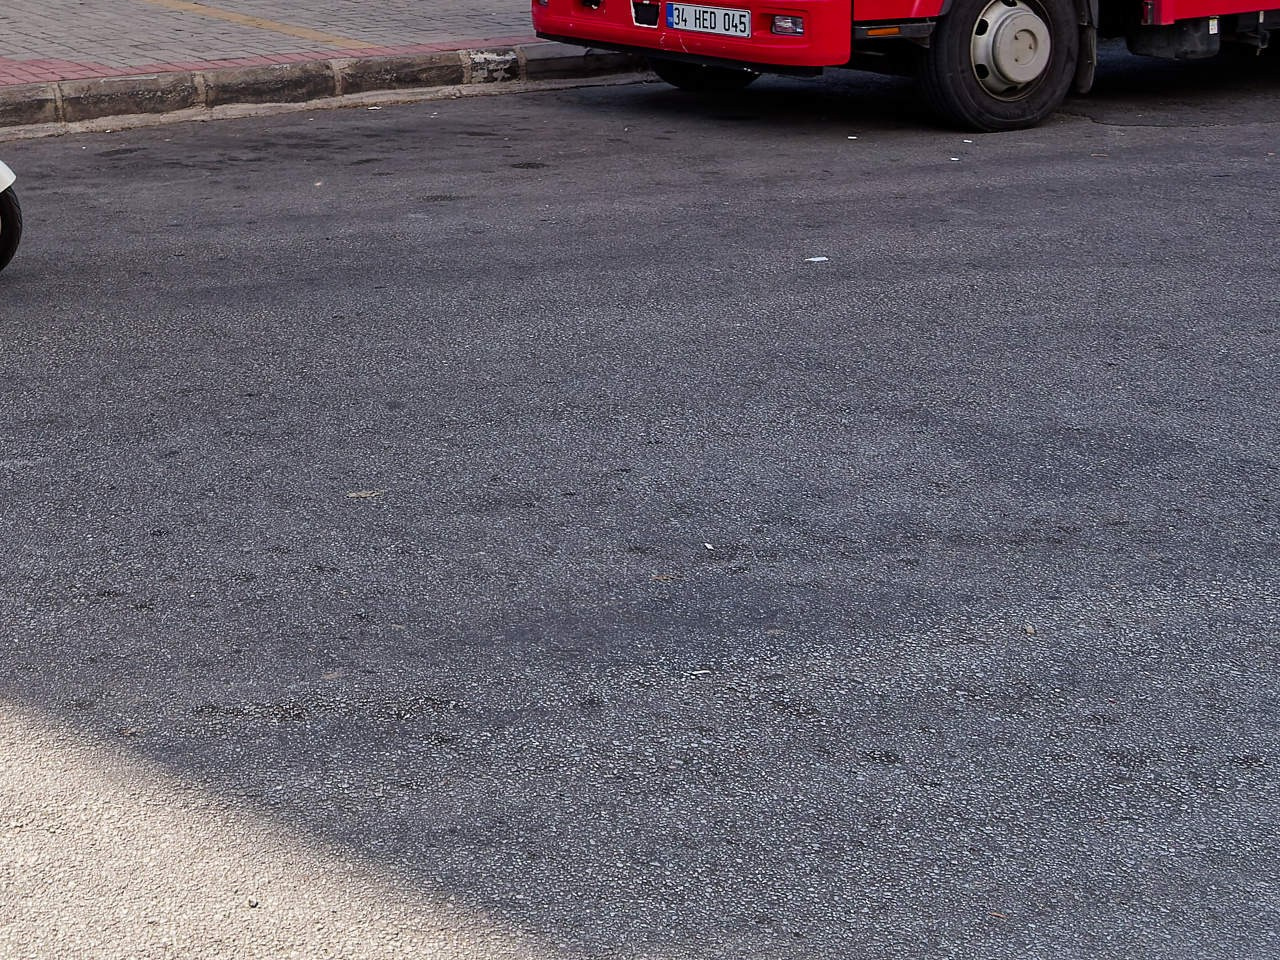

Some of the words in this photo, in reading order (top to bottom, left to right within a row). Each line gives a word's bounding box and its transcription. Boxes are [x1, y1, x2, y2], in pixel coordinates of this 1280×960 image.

[674, 7, 688, 27] 34
[694, 9, 717, 30] HED
[723, 13, 747, 33] 045
